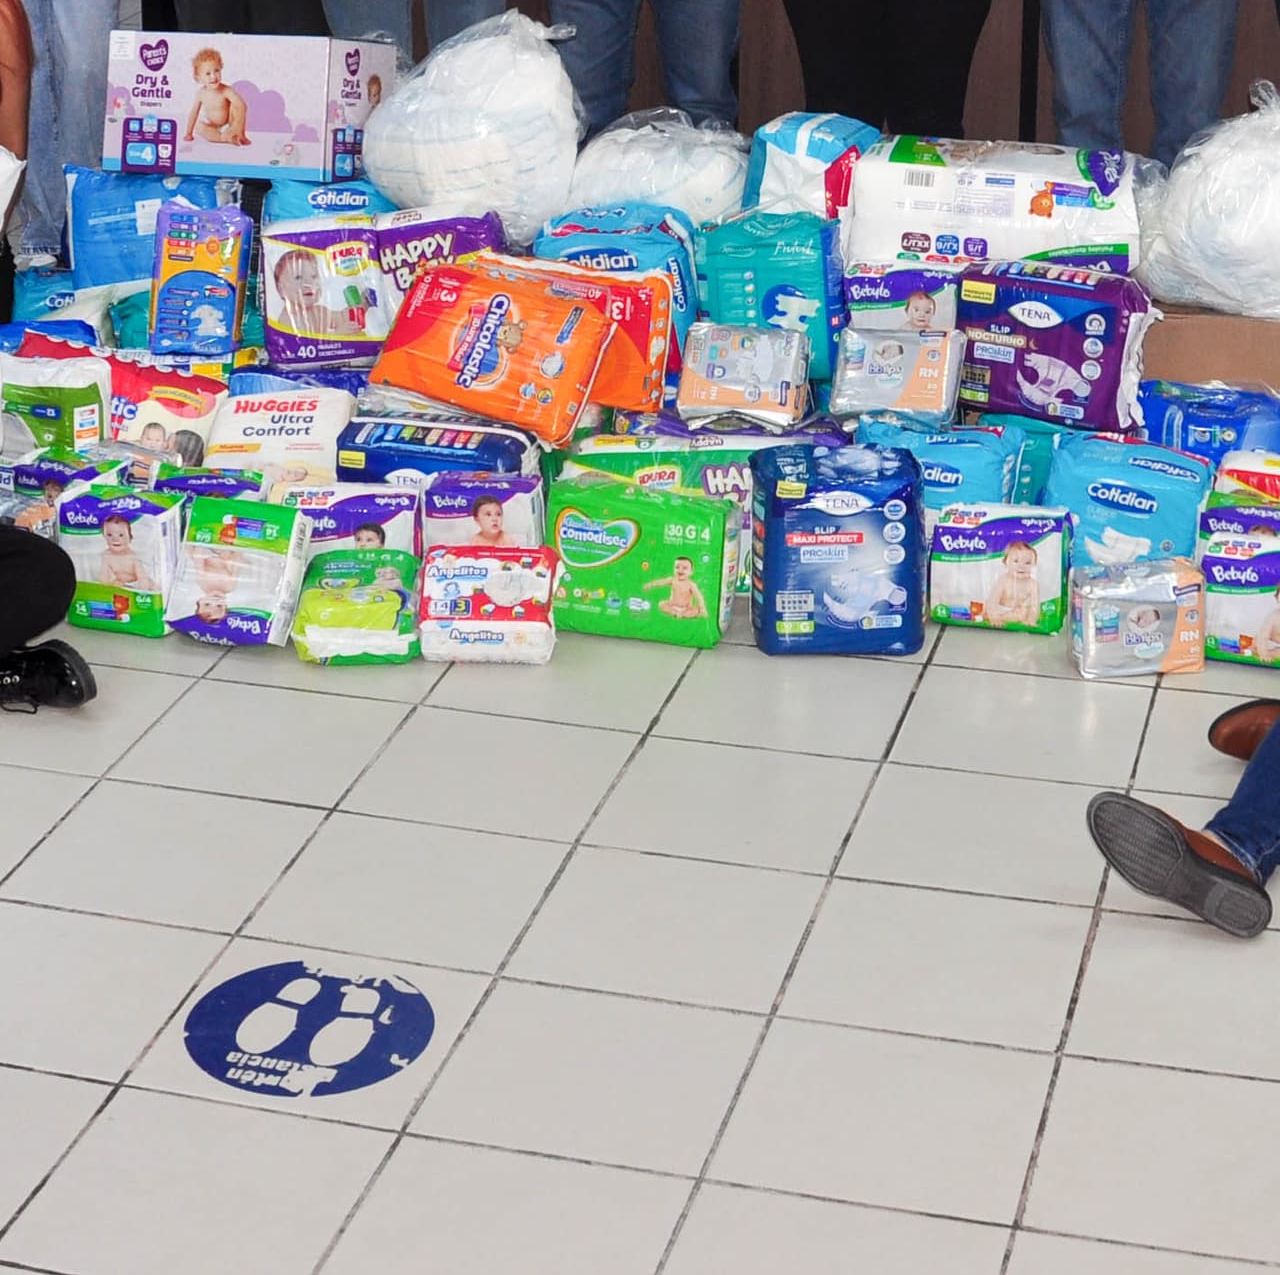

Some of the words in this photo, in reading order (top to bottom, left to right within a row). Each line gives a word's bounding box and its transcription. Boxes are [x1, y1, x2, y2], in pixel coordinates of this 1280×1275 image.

[135, 74, 157, 88] Dry
[160, 75, 169, 86] &
[131, 86, 172, 99] Gentle
[140, 146, 153, 163] 4
[307, 188, 370, 207] Cotidian
[378, 233, 454, 272] HAPPY
[849, 282, 891, 300] Bebyto
[1020, 307, 1052, 322] TENA
[990, 325, 1011, 335] SLIP
[456, 293, 511, 389] Chicolastic
[967, 330, 1026, 347] NOCTURNO
[297, 345, 317, 359] 40
[919, 367, 940, 378] RN
[233, 398, 319, 415] HUGGIES
[270, 412, 315, 426] Ultra
[242, 424, 312, 439] Confort
[431, 493, 468, 509] Bebyto
[824, 497, 860, 510] TENA
[1086, 482, 1159, 513] Cotidian
[65, 510, 99, 526] Bebyto
[1208, 517, 1245, 534] Bebyto
[559, 525, 629, 548] Comodisec
[685, 525, 697, 538] G
[701, 527, 711, 540] 4
[793, 535, 816, 544] MAXI
[818, 534, 859, 543] PROTECT
[939, 535, 988, 551] Bebyto
[427, 564, 489, 579] Angelitos
[1212, 565, 1259, 584] Bebyto
[455, 599, 468, 613] 3
[226, 615, 262, 636] Bebyto
[448, 628, 505, 643] Angelitos
[1179, 629, 1201, 643] RN
